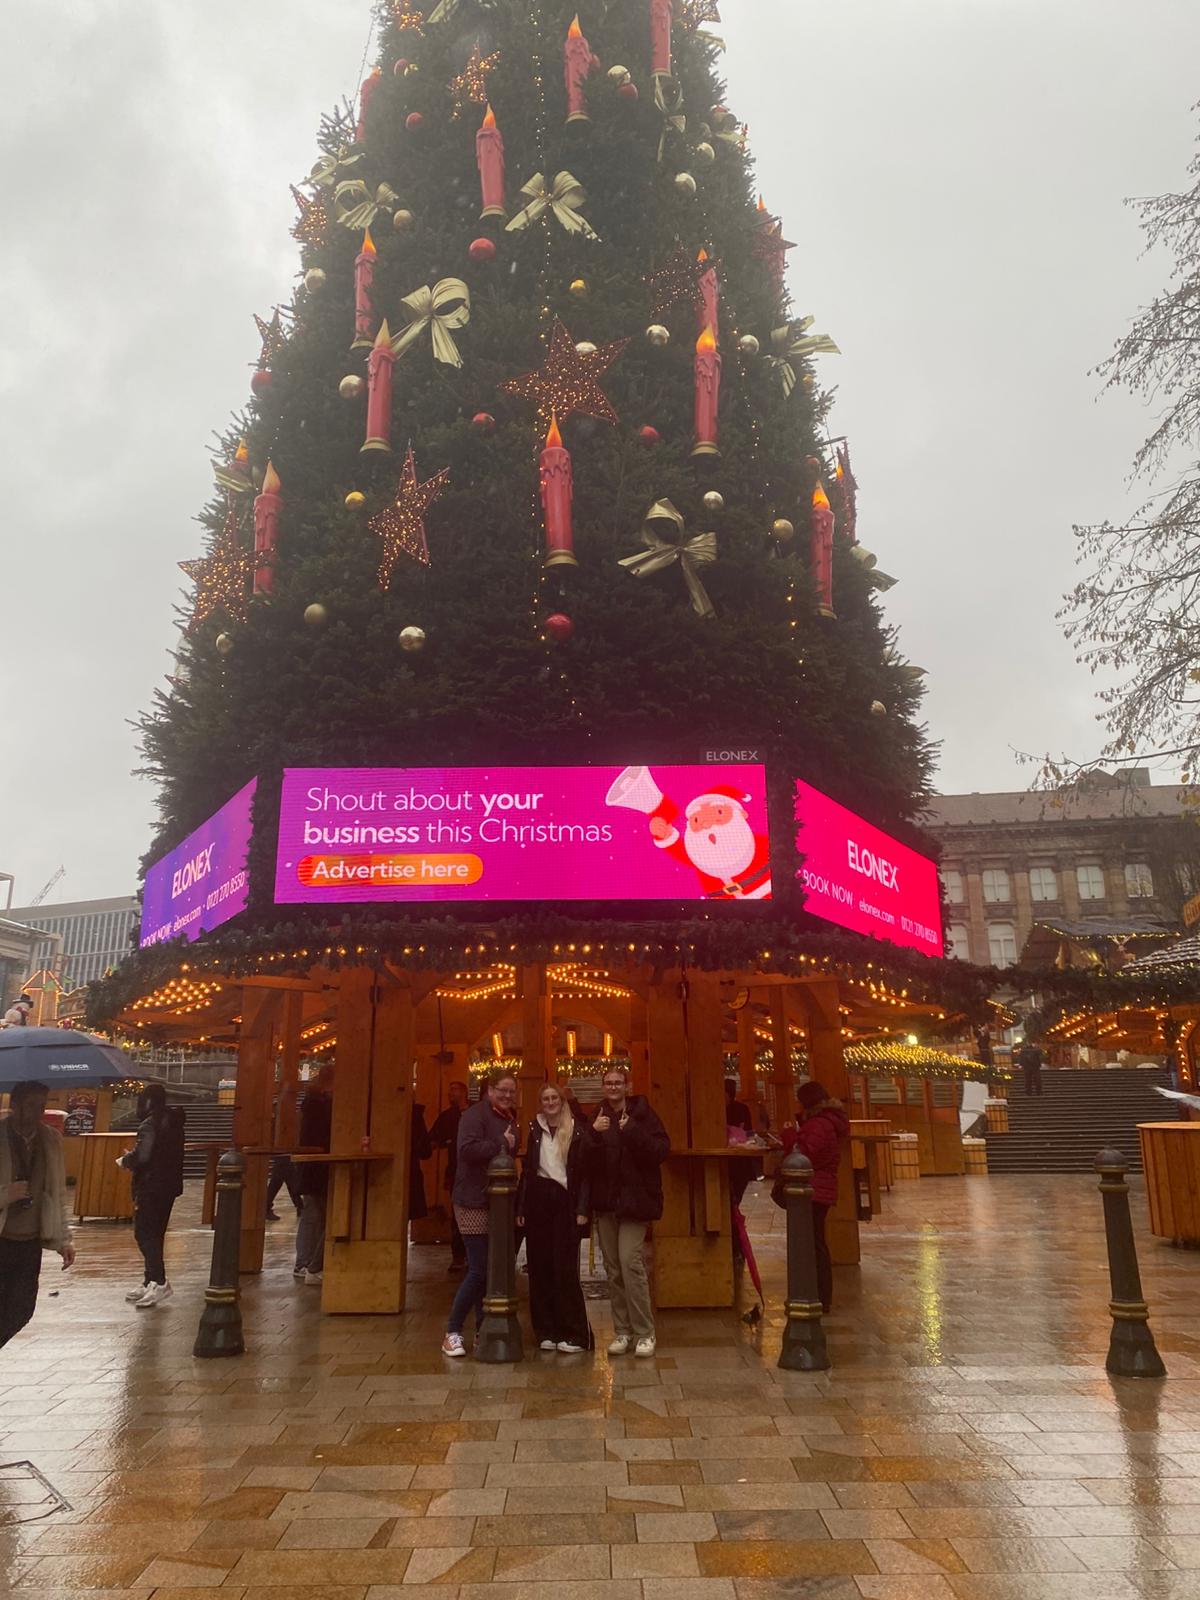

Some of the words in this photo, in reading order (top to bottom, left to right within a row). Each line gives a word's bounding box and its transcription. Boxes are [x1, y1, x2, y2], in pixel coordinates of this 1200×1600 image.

[705, 750, 759, 762] ELONEX
[305, 787, 387, 812] Shout
[393, 787, 473, 811] about
[480, 792, 544, 817] your
[303, 819, 420, 844] business
[426, 819, 473, 843] this
[479, 817, 613, 843] Christmas
[171, 842, 216, 899] ELONEX
[312, 860, 416, 879] Advertise
[421, 860, 469, 878] here
[847, 838, 900, 892] ELONEX
[802, 868, 831, 897] BOOK
[859, 898, 896, 926] elonex.com
